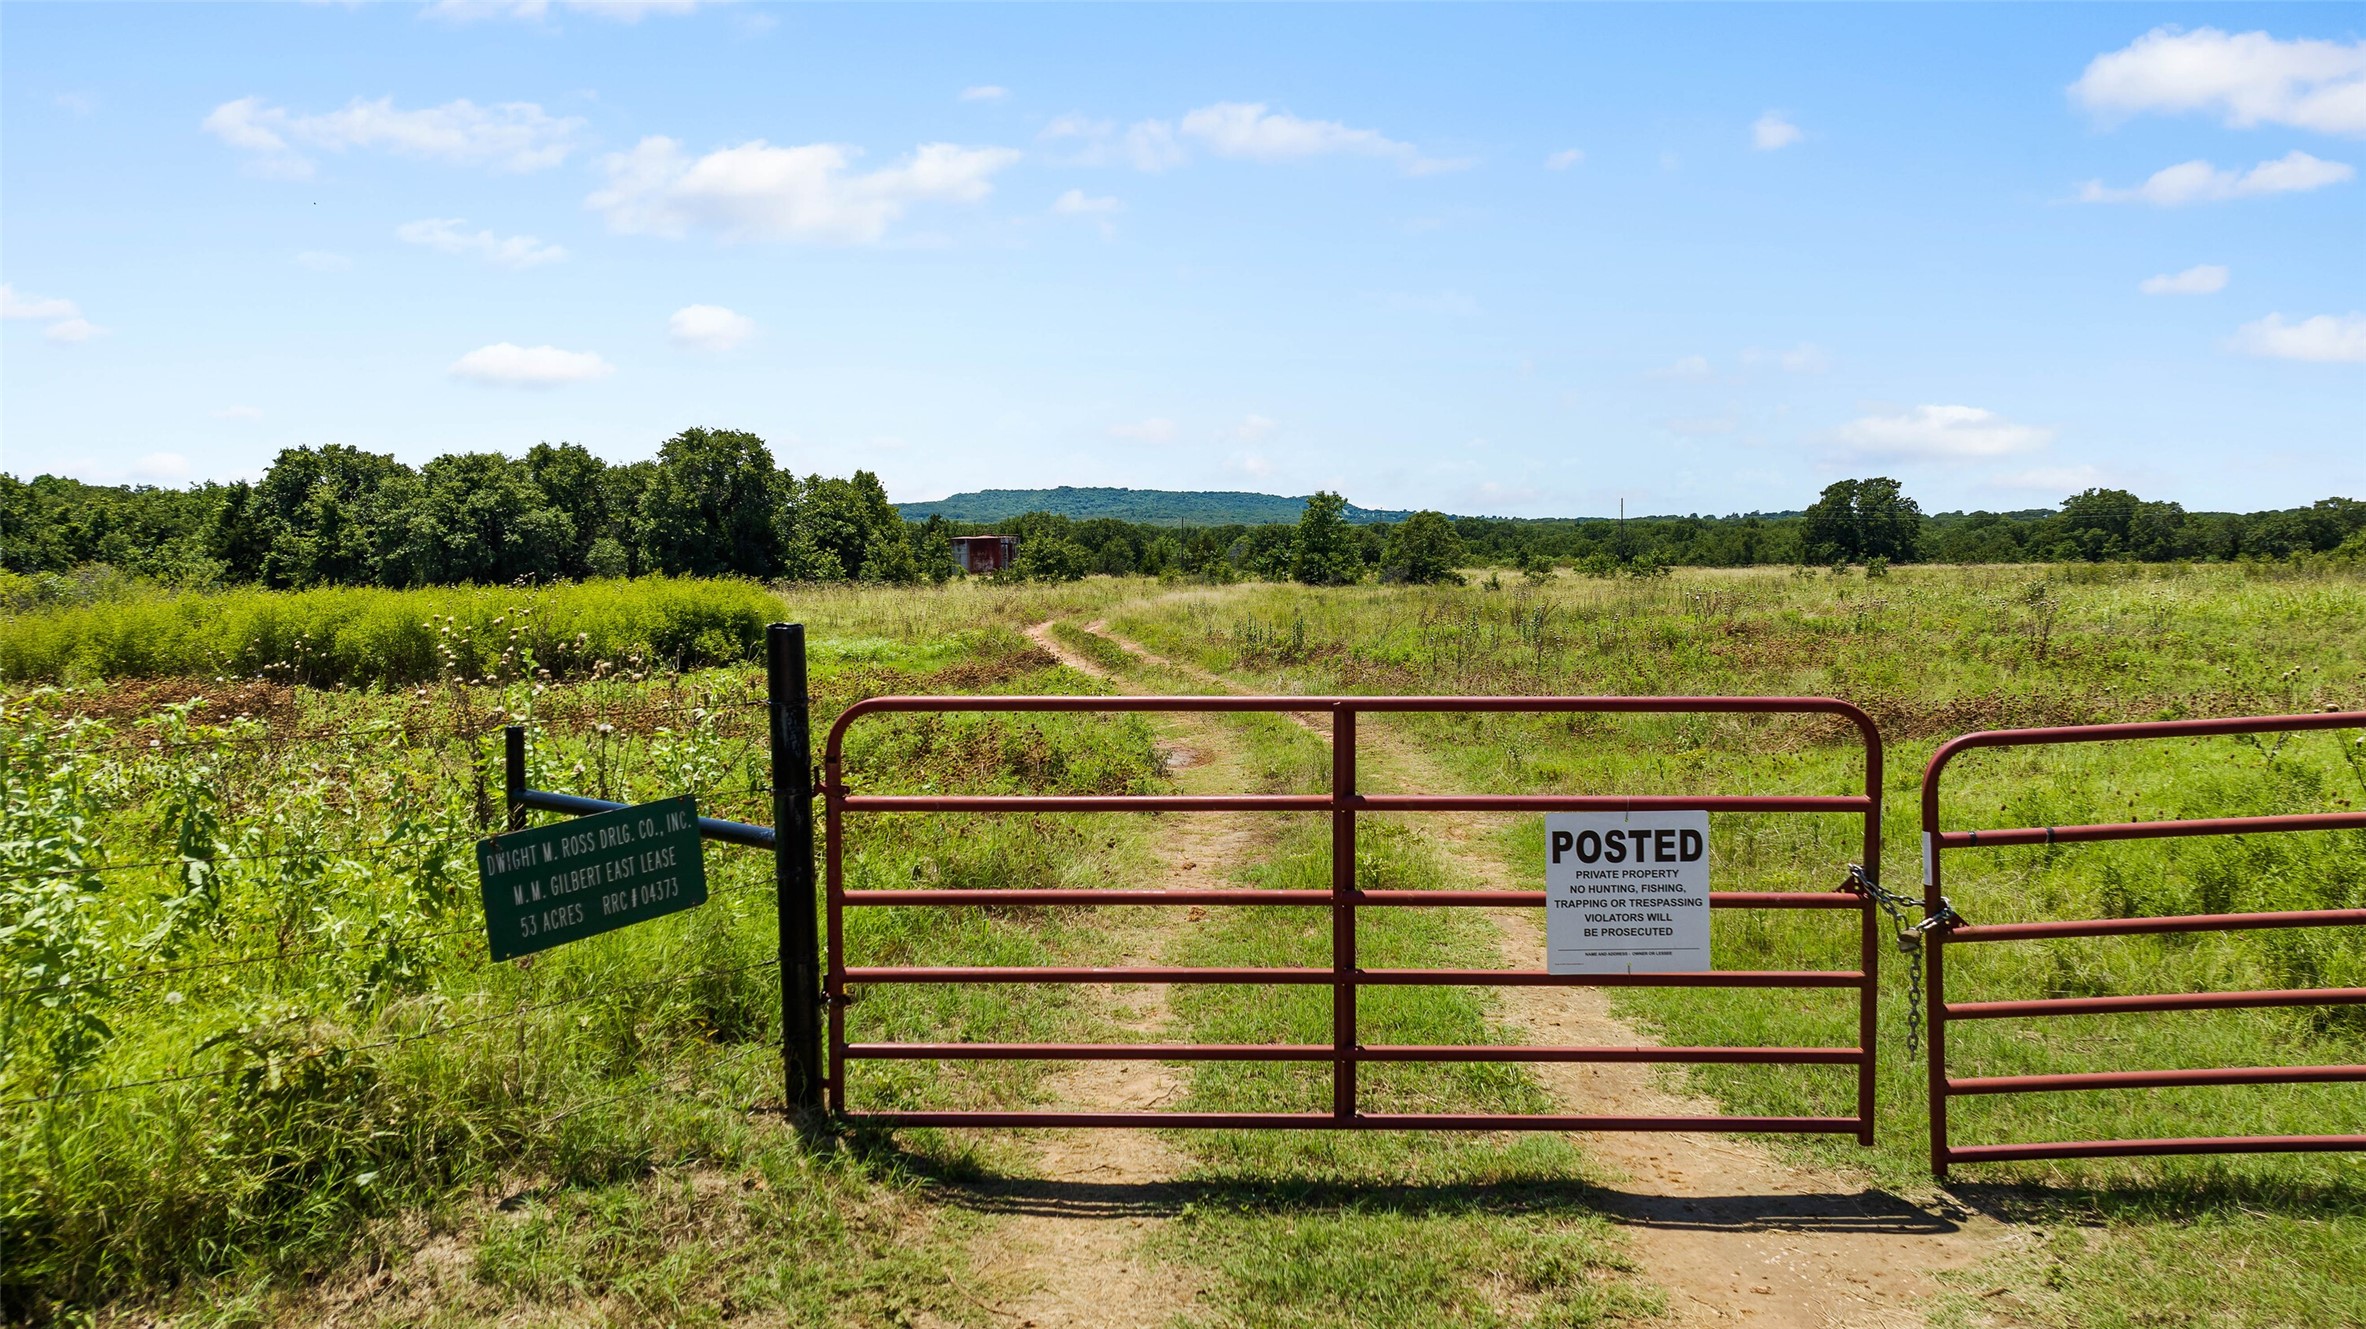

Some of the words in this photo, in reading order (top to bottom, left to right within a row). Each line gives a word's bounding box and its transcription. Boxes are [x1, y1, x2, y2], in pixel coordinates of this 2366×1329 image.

[487, 845, 537, 876] DWIGHT
[543, 842, 558, 863] M.
[562, 832, 595, 858] ROSS
[600, 824, 635, 849] DRLG.
[639, 818, 664, 838] CO.,
[666, 810, 692, 833] INC.
[1552, 829, 1703, 864] POSTED
[513, 885, 529, 905] M.
[531, 881, 547, 901] M.
[550, 865, 601, 897] GILBERT
[606, 856, 635, 882] EAST
[640, 846, 677, 873] LEASE
[1576, 870, 1619, 879] PRIVATE
[1622, 870, 1679, 878] PROPERTY
[1570, 885, 1585, 893] NO
[1588, 885, 1638, 894] HUNTING,
[1641, 884, 1686, 893] FISHING,
[521, 915, 537, 938] 53
[543, 903, 584, 932] ACRES
[602, 890, 627, 915] RRC
[641, 877, 679, 905] 04373
[1555, 900, 1608, 908] TRAPPING
[1610, 899, 1626, 908] OR
[1629, 898, 1702, 907] TRESPASSING
[1585, 913, 1644, 922] VIOLATORS
[1647, 913, 1672, 921] WILL
[1601, 928, 1673, 936] PROSECUTED
